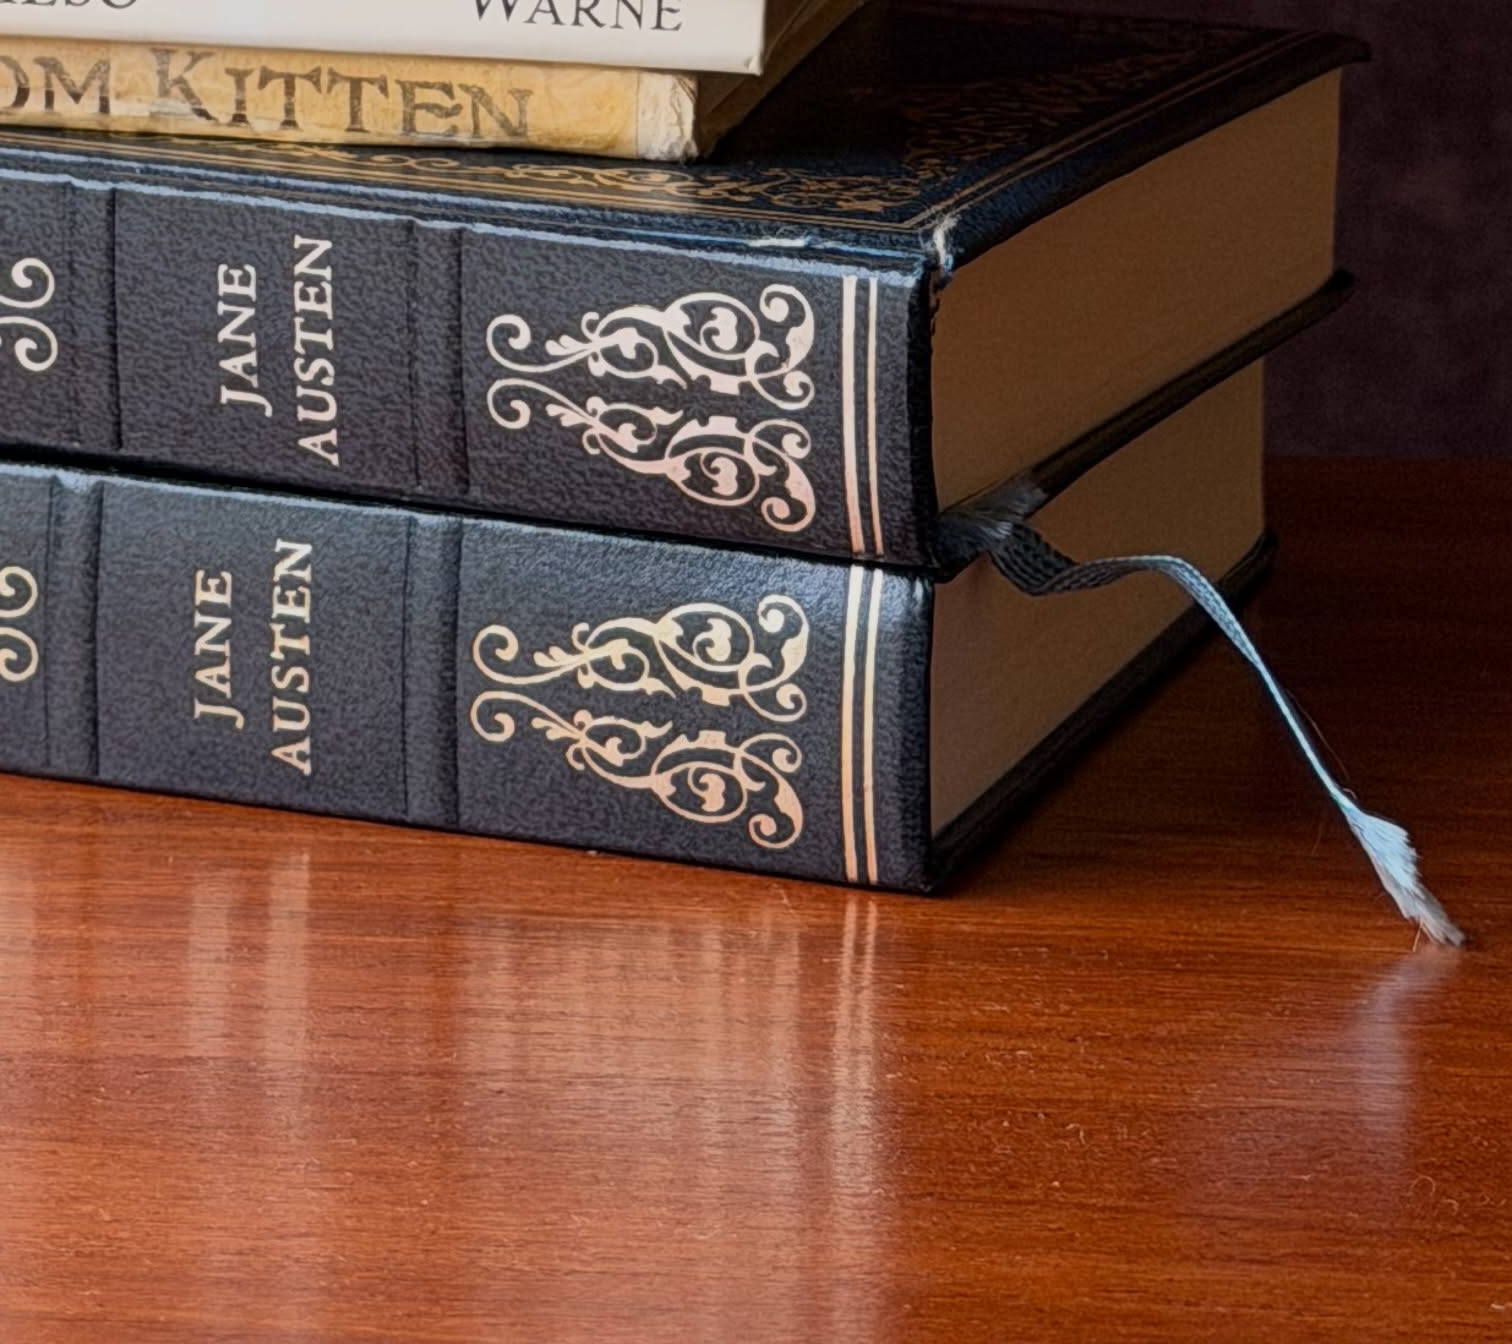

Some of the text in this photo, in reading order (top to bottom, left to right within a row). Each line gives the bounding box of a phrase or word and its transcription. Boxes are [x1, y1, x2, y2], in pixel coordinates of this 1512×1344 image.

[148, 48, 533, 139] KITTEN
[218, 263, 272, 417] JANE
[294, 235, 339, 467] AUSTEN
[194, 569, 244, 730] JANE
[272, 538, 312, 776] AUSTEN
